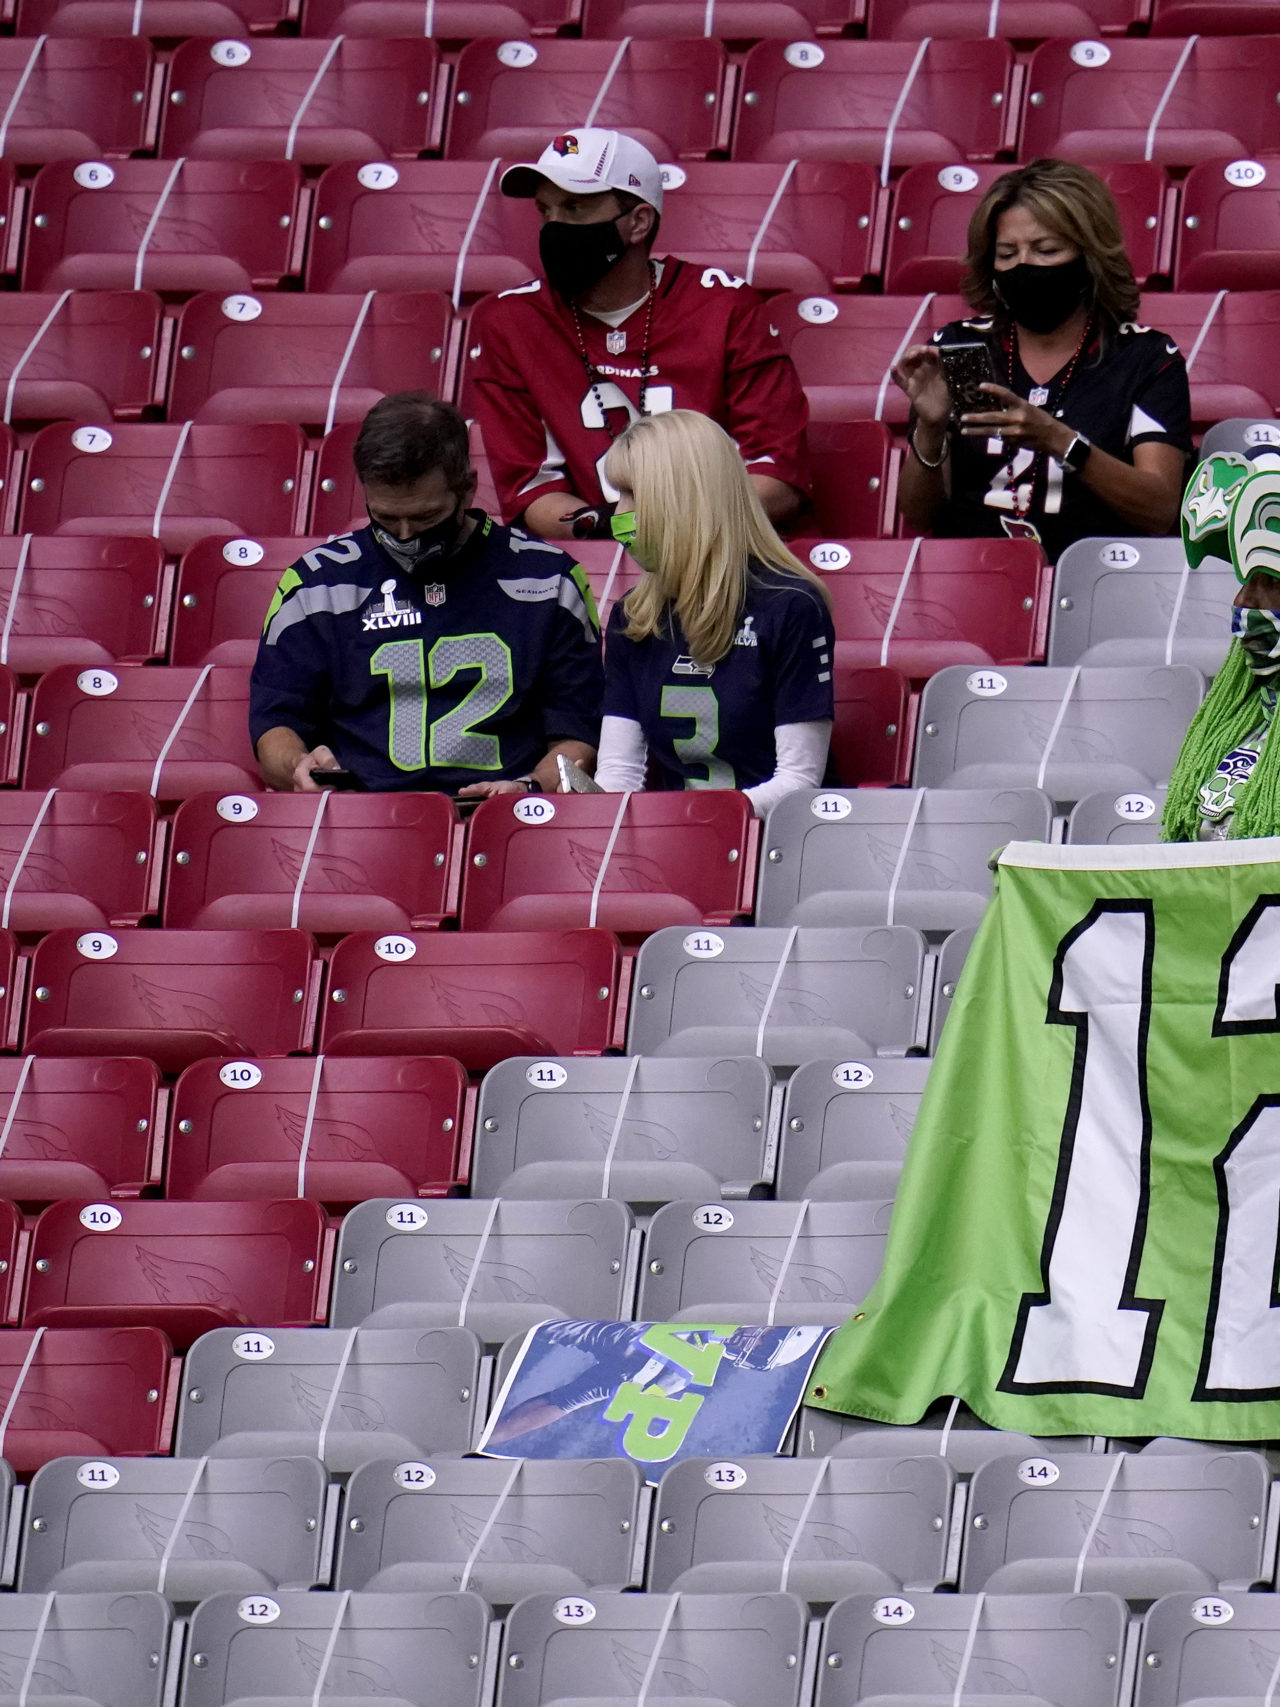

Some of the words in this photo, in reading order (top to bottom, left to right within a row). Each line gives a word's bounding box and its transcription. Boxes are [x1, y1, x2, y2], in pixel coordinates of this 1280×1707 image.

[513, 49, 522, 60] 7
[1085, 48, 1095, 60] 9
[88, 169, 99, 181] 6
[374, 170, 383, 182] 7
[953, 173, 963, 185] 9
[1236, 169, 1254, 180] 10
[237, 302, 246, 313] 7
[812, 304, 823, 316] 9
[87, 434, 97, 445] 7
[1254, 431, 1272, 443] 11
[238, 546, 248, 559] 8
[819, 550, 841, 563] 10
[1110, 549, 1129, 562] 11
[361, 611, 422, 632] XLVIII
[92, 676, 102, 689] 8
[977, 677, 996, 690] 11
[369, 631, 514, 772] 12
[660, 684, 736, 790] 3
[232, 802, 243, 815] 9
[524, 804, 545, 817] 10
[821, 801, 841, 813] 11
[1125, 800, 1145, 813] 12
[91, 940, 102, 952] 9
[384, 942, 406, 955] 10
[694, 938, 713, 951] 11
[230, 1069, 252, 1082] 10
[536, 1069, 556, 1082] 11
[843, 1069, 863, 1082] 12
[89, 1211, 112, 1224] 10
[397, 1211, 417, 1224] 11
[703, 1212, 723, 1225] 12
[243, 1340, 264, 1353] 11
[88, 1469, 108, 1482] 11
[404, 1469, 425, 1483] 12
[715, 1469, 736, 1483] 13
[1027, 1465, 1049, 1479] 14
[248, 1603, 268, 1617] 12
[564, 1605, 584, 1618] 13
[883, 1605, 903, 1617] 14
[1201, 1604, 1222, 1618] 15
